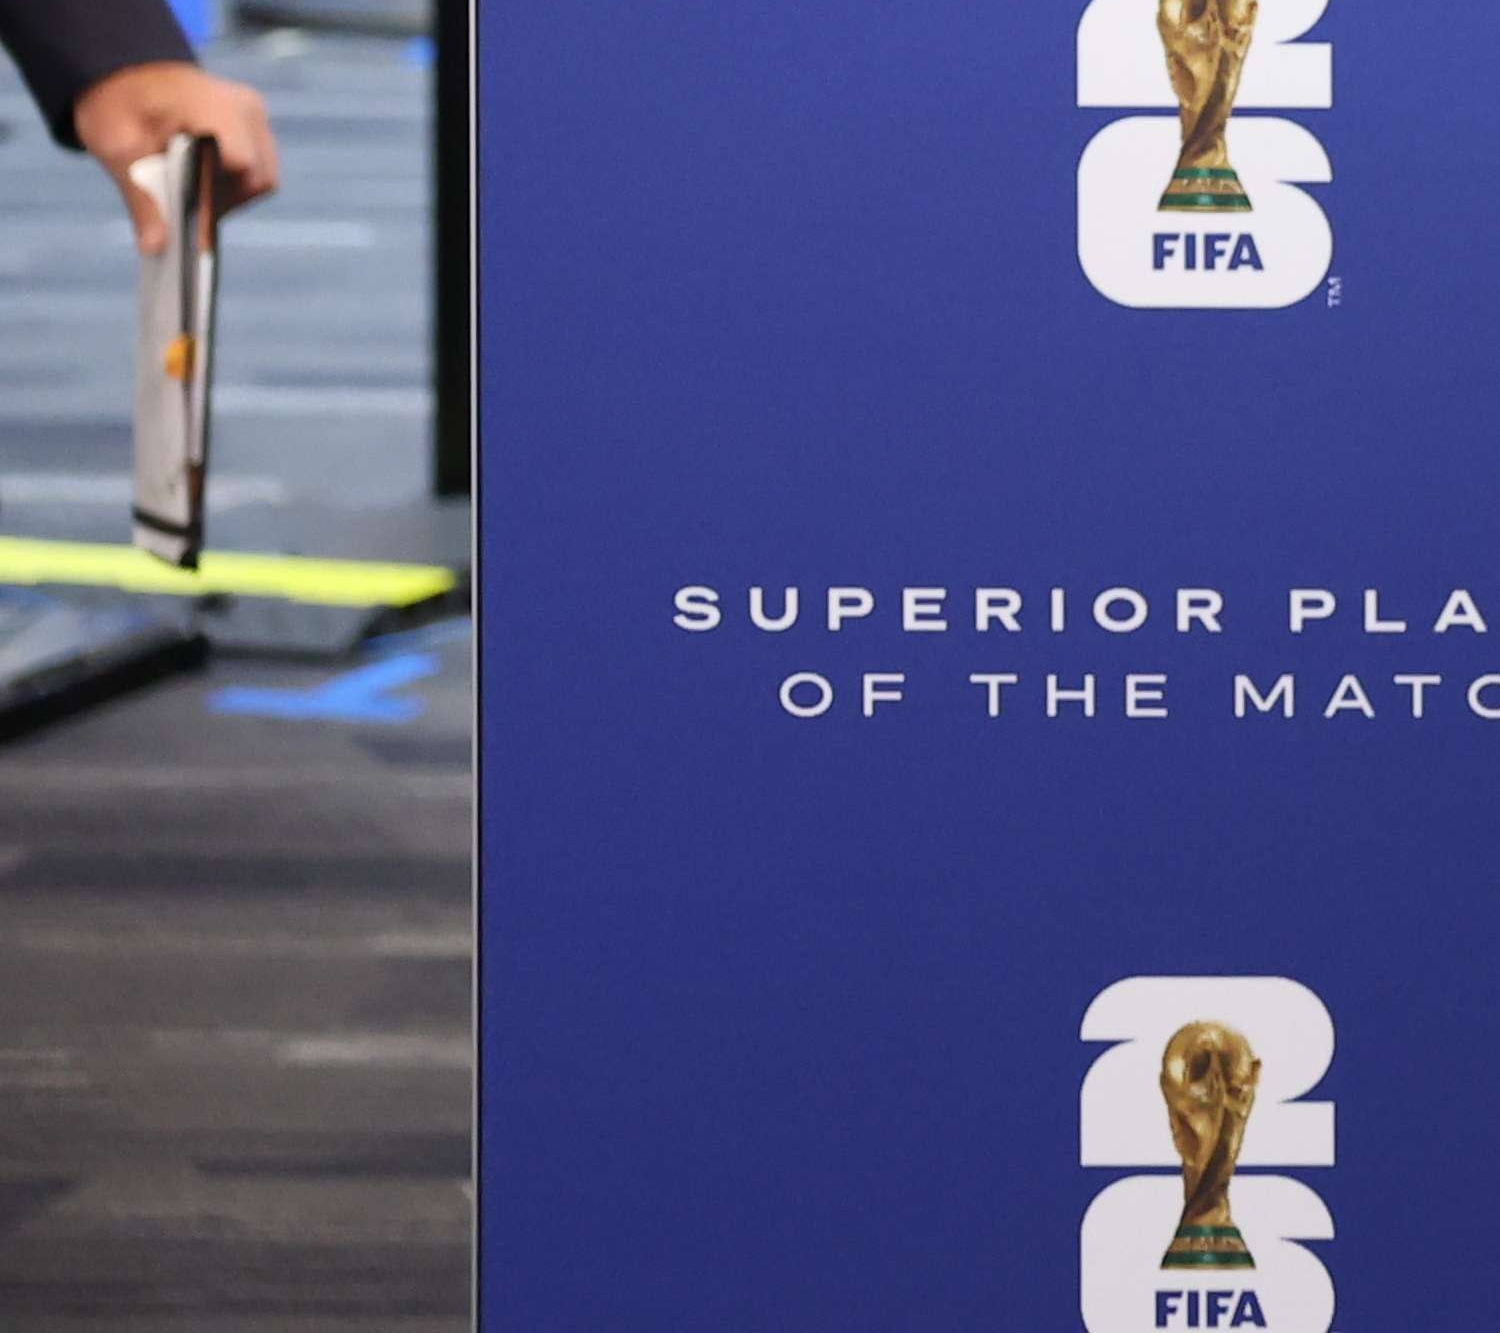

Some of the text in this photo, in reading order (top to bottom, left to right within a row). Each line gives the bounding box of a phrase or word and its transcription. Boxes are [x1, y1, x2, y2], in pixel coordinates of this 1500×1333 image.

[1152, 232, 1265, 272] FIFA
[673, 586, 1223, 633] SUPERIOR
[779, 672, 905, 718] OF
[969, 673, 1169, 718] THE
[1154, 1290, 1267, 1329] FIFA
